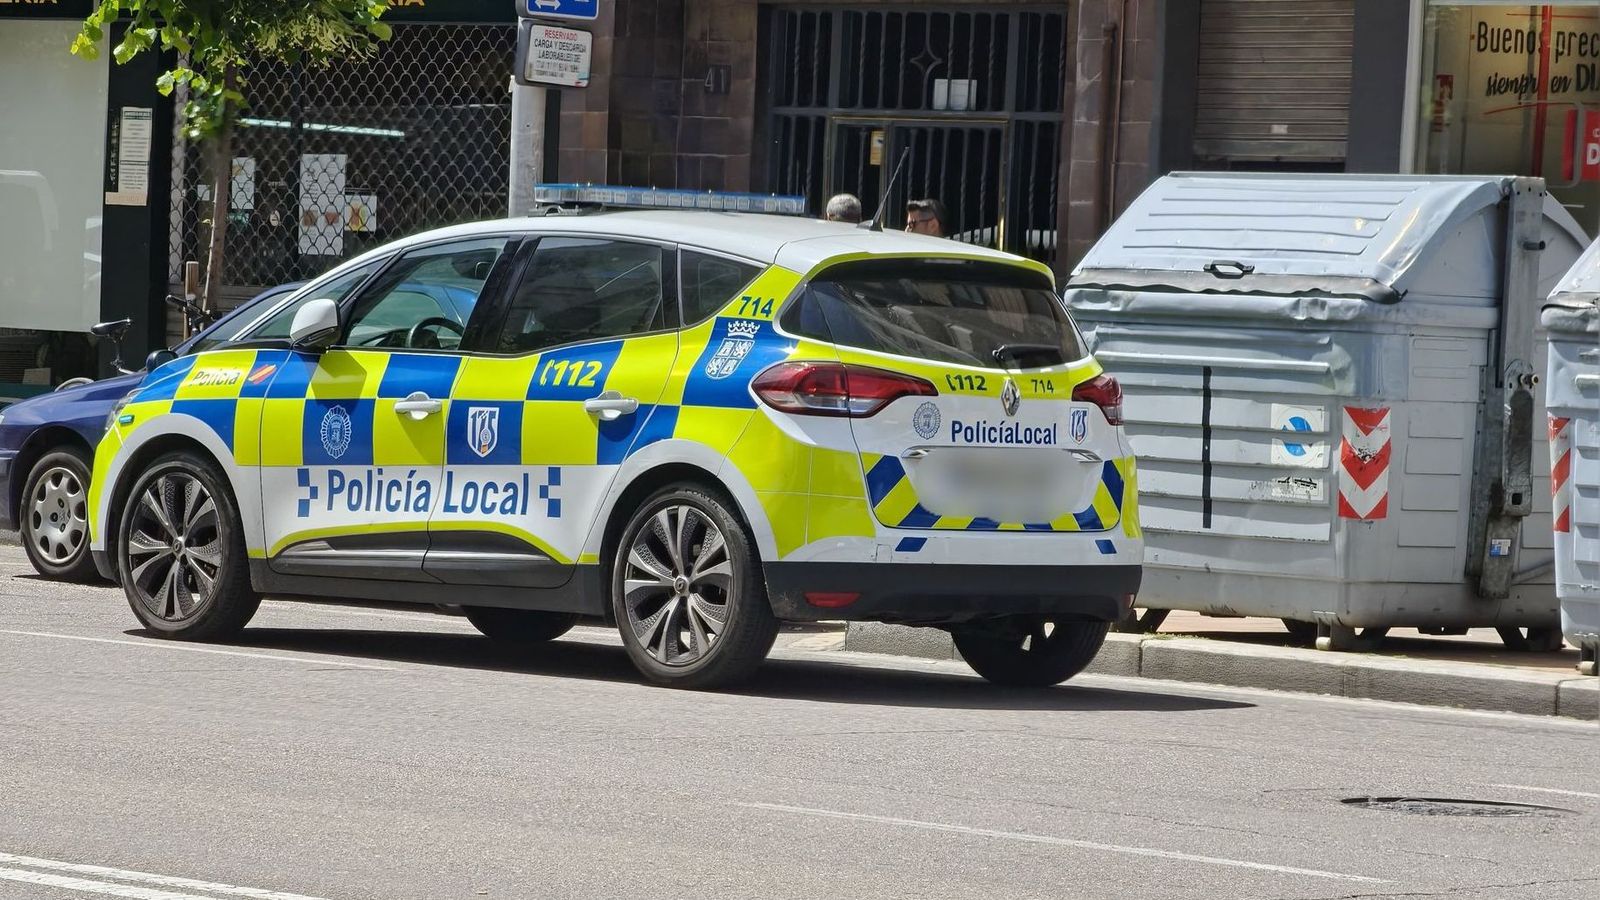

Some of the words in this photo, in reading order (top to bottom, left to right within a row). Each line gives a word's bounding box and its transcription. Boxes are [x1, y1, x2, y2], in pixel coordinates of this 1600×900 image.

[545, 29, 577, 41] RESERVADO
[534, 39, 553, 49] CARGA
[559, 41, 586, 53] DESCARGA
[1485, 72, 1538, 105] siempr
[1551, 76, 1572, 93] en
[739, 296, 774, 317] 714
[552, 360, 602, 387] 112
[1031, 379, 1054, 393] 714
[327, 468, 431, 513] Policía
[443, 470, 528, 515] Local
